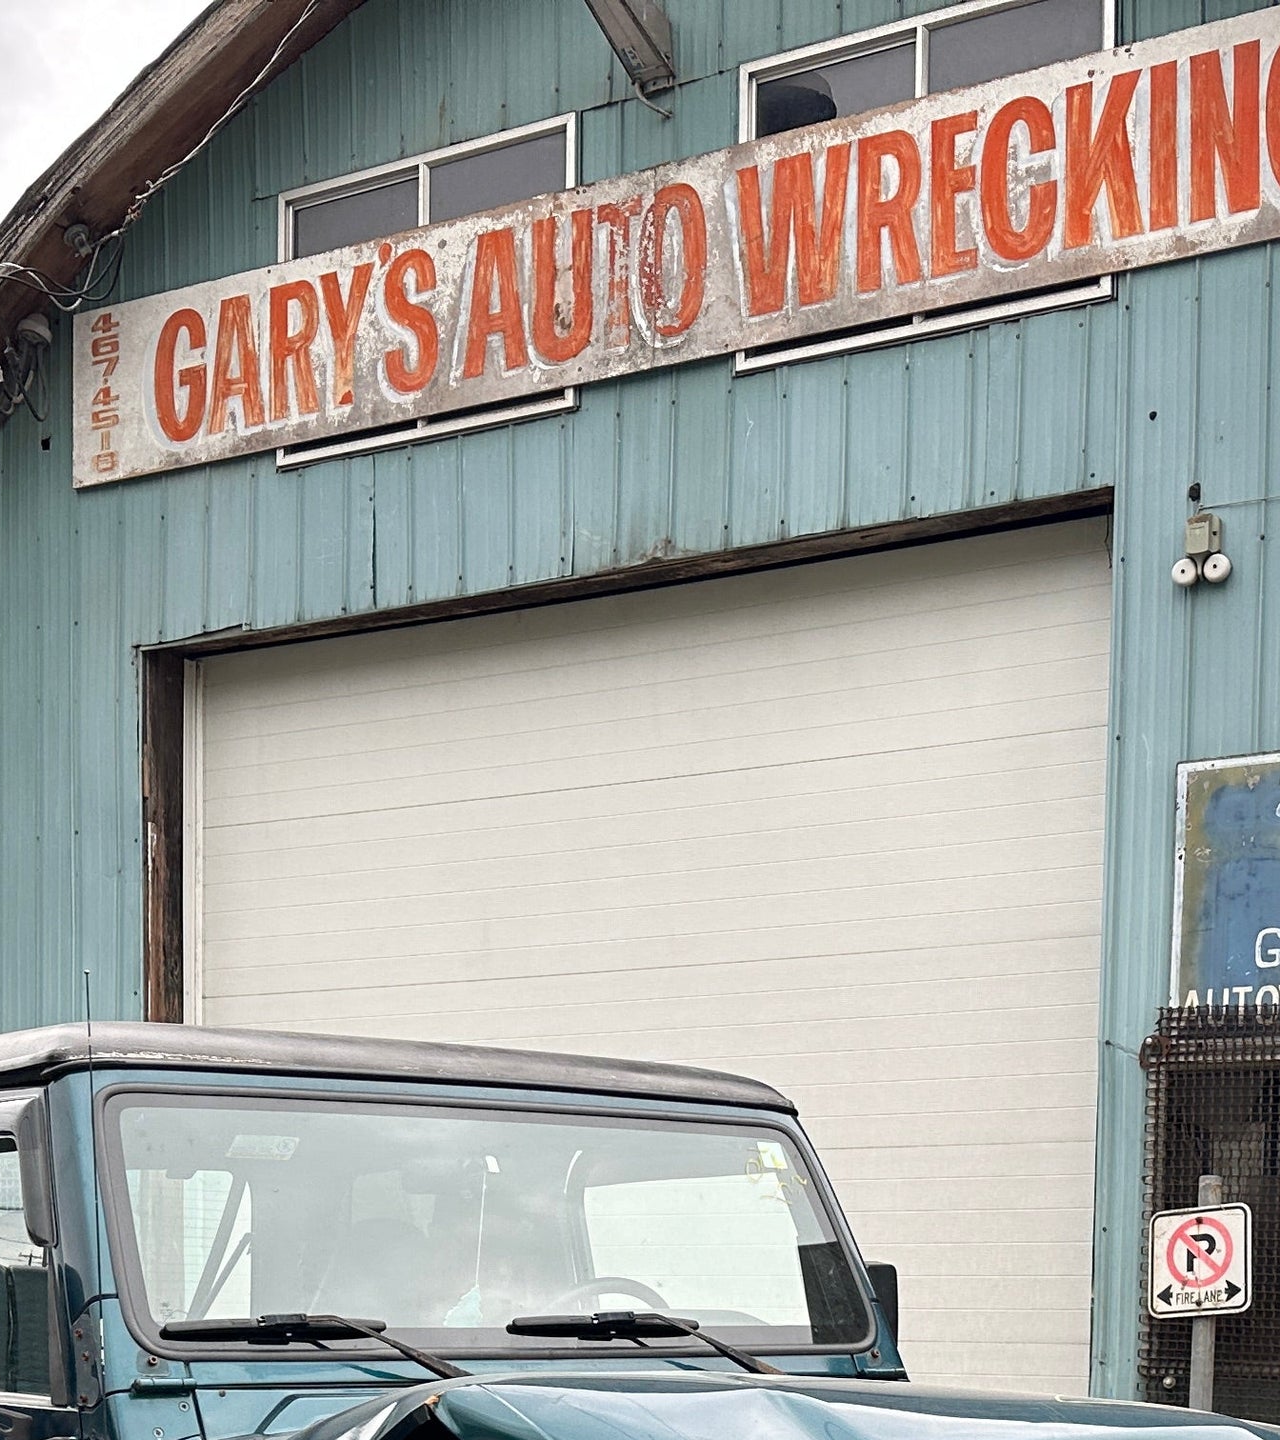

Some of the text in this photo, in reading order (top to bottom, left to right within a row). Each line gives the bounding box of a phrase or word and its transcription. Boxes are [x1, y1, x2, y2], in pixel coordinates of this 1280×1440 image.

[153, 243, 439, 441] GARY'S
[462, 183, 708, 379] AUTO
[1175, 1291, 1196, 1306] FIRE
